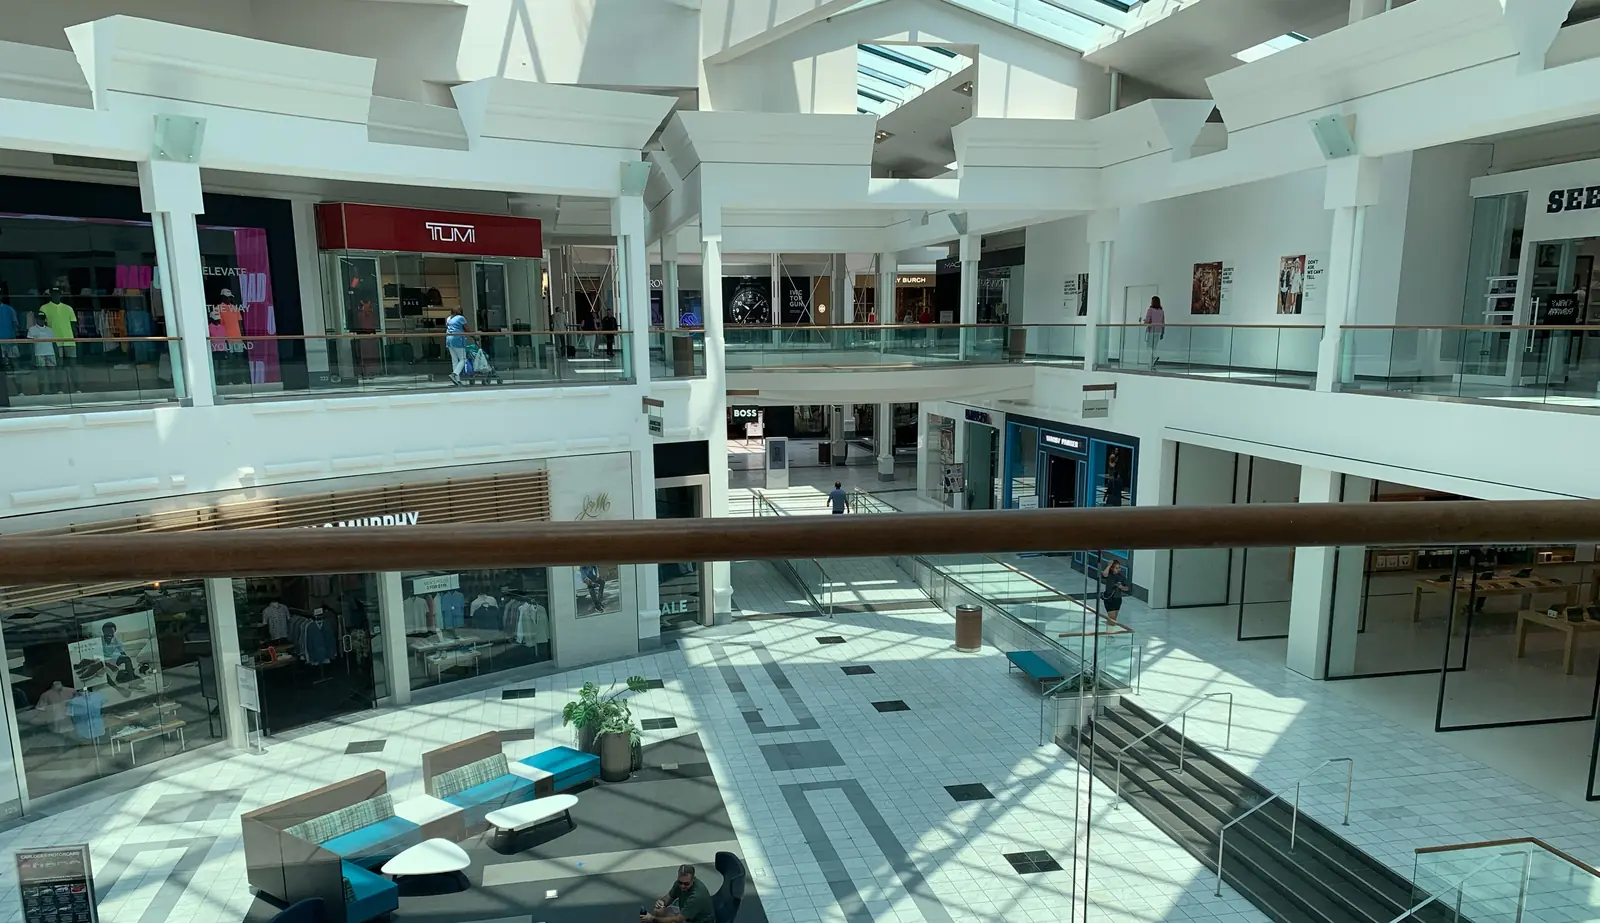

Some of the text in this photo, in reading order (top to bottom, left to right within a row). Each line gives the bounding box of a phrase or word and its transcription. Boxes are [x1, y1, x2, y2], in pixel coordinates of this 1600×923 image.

[425, 222, 476, 243] TUMI
[202, 266, 247, 277] ELEVATE
[206, 305, 251, 313] THE WAY
[734, 409, 758, 417] BOSS
[660, 600, 688, 615] ALE
